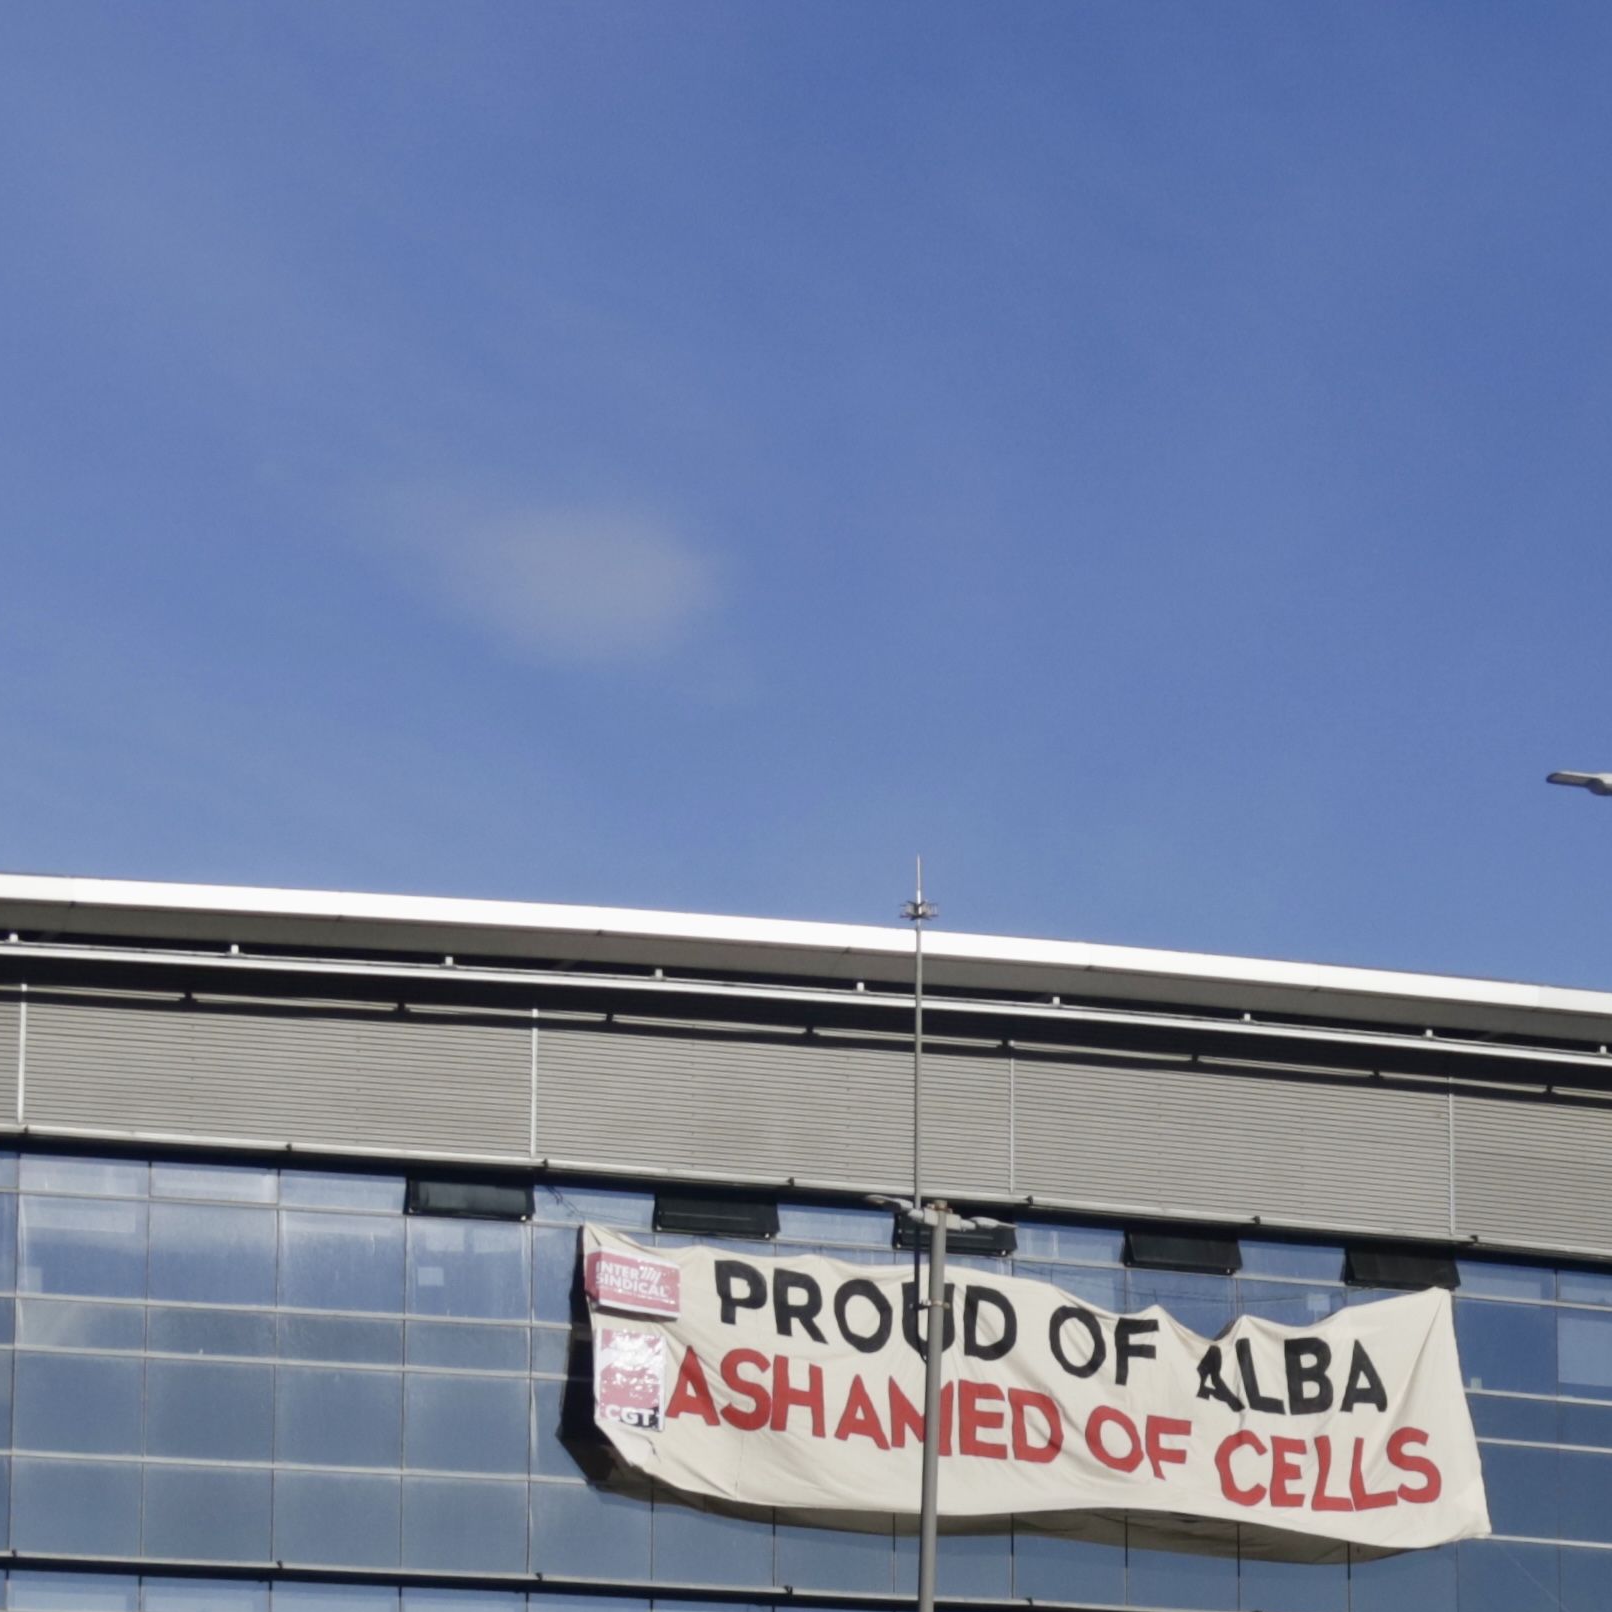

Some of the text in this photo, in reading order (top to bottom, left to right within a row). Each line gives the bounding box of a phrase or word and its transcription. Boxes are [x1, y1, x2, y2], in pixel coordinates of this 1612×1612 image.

[596, 1260, 639, 1279] INTER
[596, 1273, 668, 1298] SINDICAL
[714, 1259, 1388, 1415] PROUD OF ALBA
[605, 1404, 654, 1426] CGT
[665, 1345, 1442, 1511] ASHAMED OF CELLS
